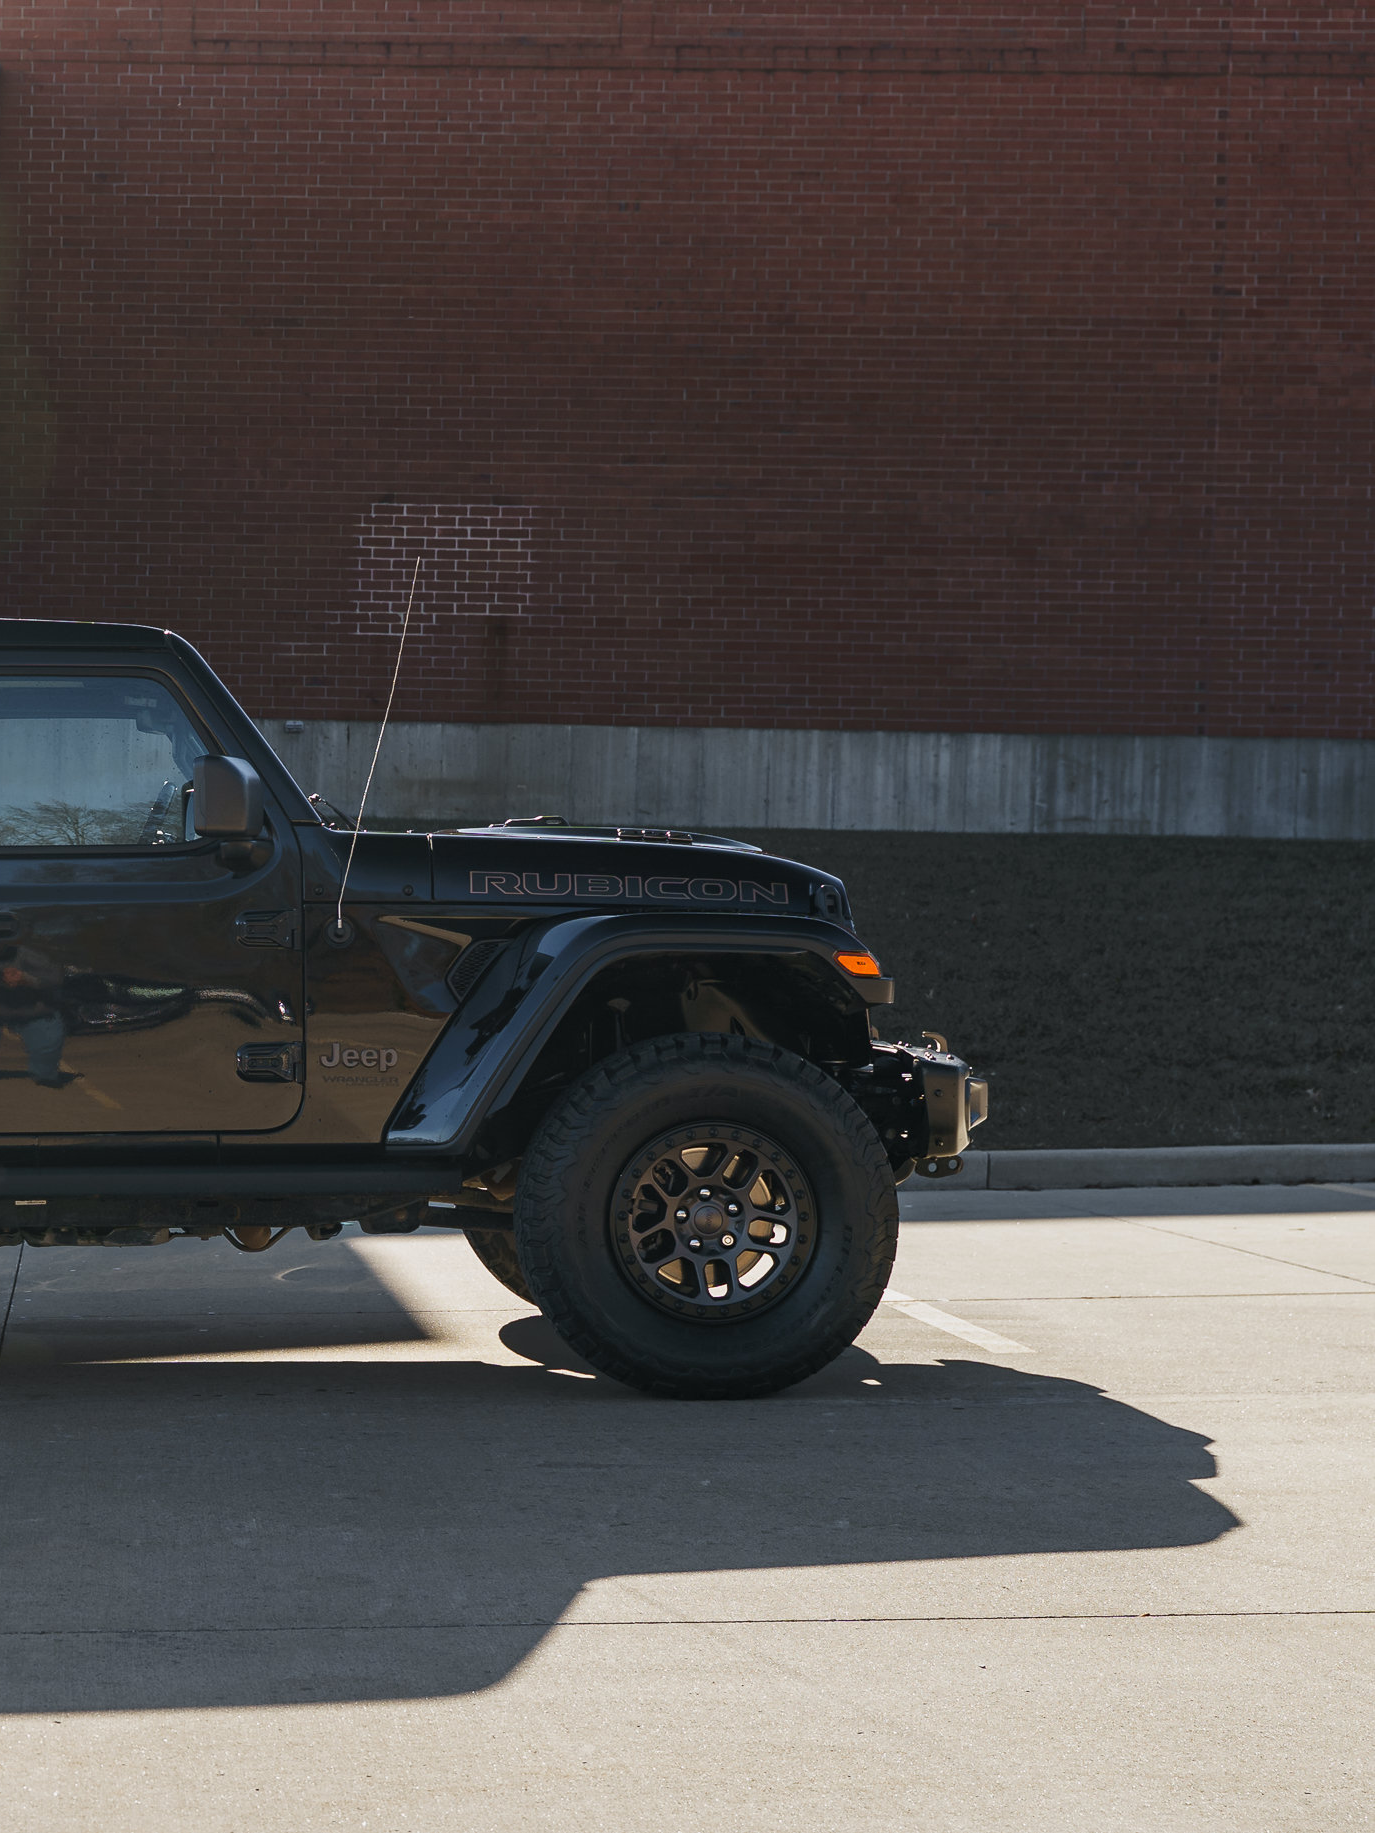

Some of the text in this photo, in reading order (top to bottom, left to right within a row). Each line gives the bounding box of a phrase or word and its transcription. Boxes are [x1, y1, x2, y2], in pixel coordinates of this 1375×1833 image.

[469, 870, 789, 905] RUBICON
[320, 1043, 399, 1072] Jeep
[322, 1076, 399, 1084] WRANGLER
